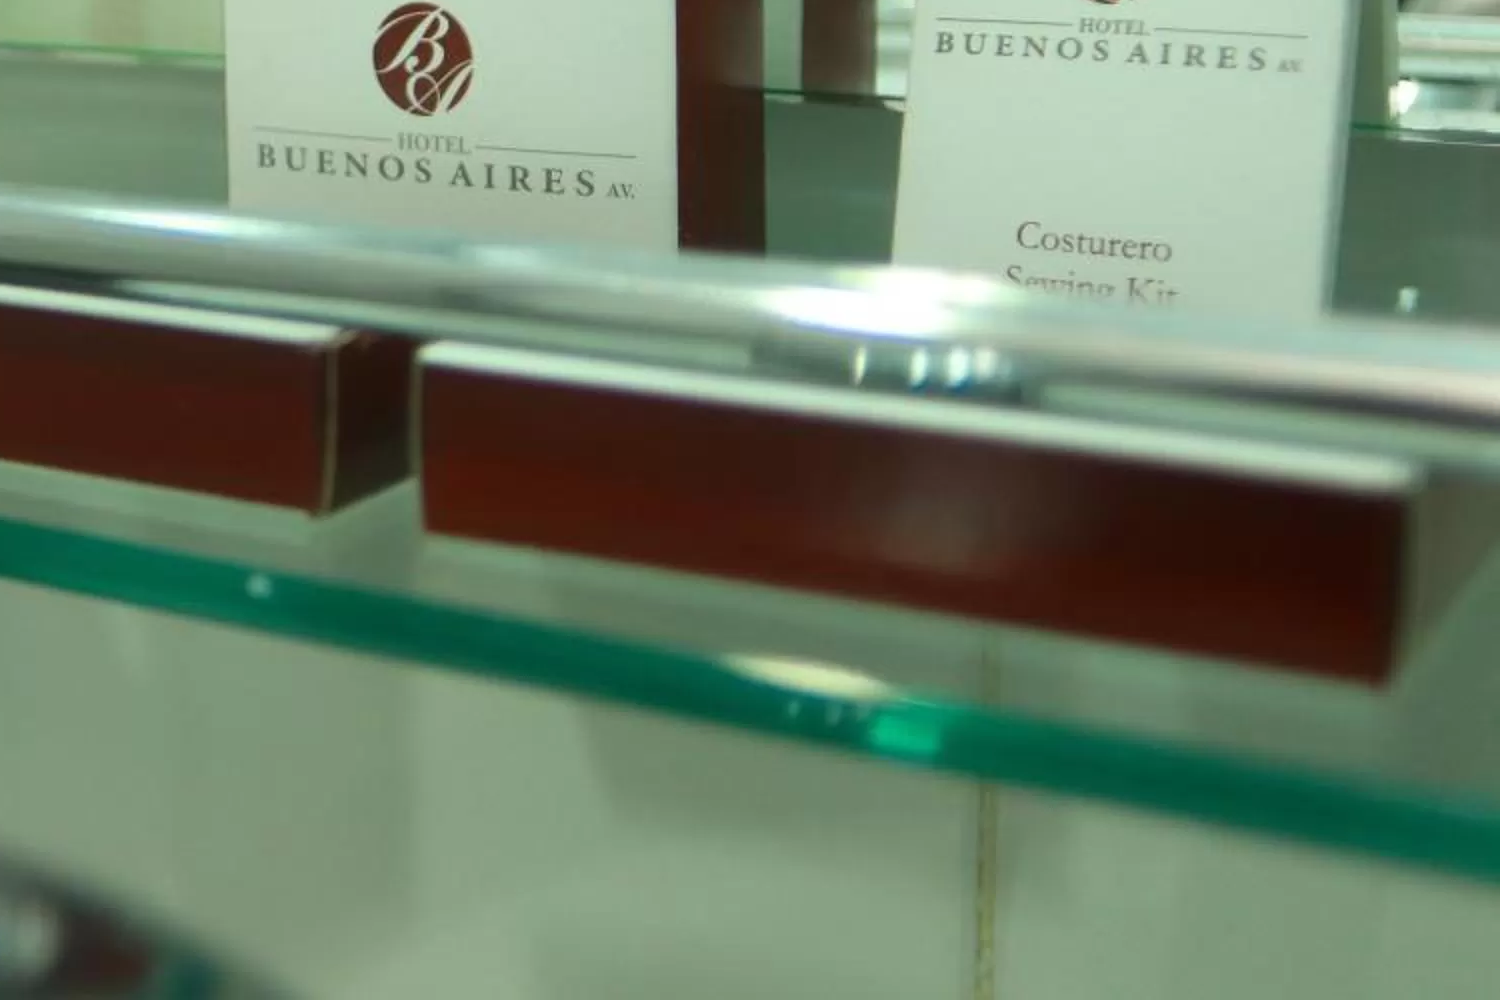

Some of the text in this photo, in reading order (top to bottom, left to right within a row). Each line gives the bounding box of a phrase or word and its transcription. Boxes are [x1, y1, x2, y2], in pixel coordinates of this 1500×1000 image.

[1079, 18, 1151, 37] HOTEL
[934, 31, 1109, 62] BUENOS
[1124, 40, 1268, 72] AIRES
[398, 131, 472, 155] HOTEL
[257, 143, 433, 184] BUENOS
[450, 161, 597, 198] AIRES
[1016, 220, 1173, 262] Costurero
